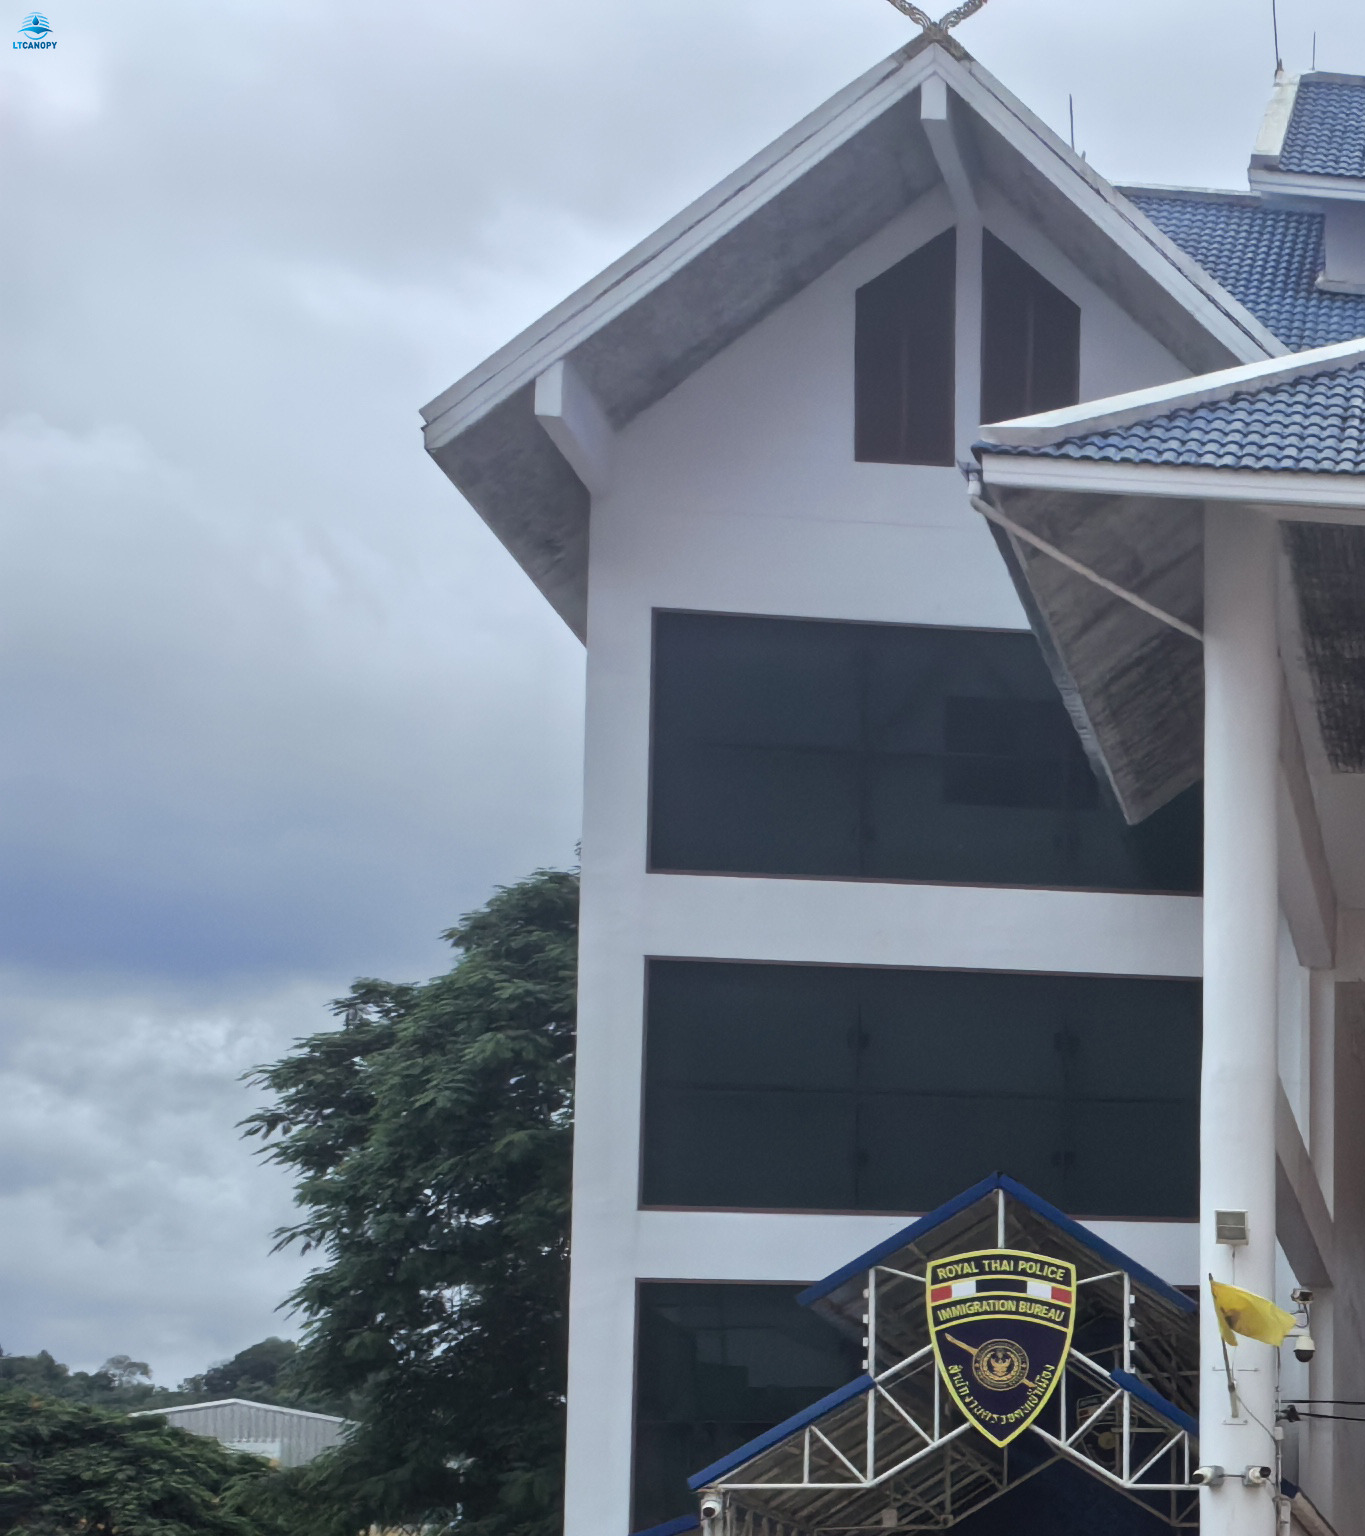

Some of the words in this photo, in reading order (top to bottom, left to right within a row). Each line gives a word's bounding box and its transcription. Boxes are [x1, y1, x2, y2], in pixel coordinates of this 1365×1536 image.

[936, 1261, 979, 1280] ROYAL
[982, 1259, 1014, 1272] THAI
[1018, 1260, 1066, 1281] POLICE
[937, 1299, 1017, 1321] IMMIGRATION
[1018, 1301, 1065, 1322] BUREAU
